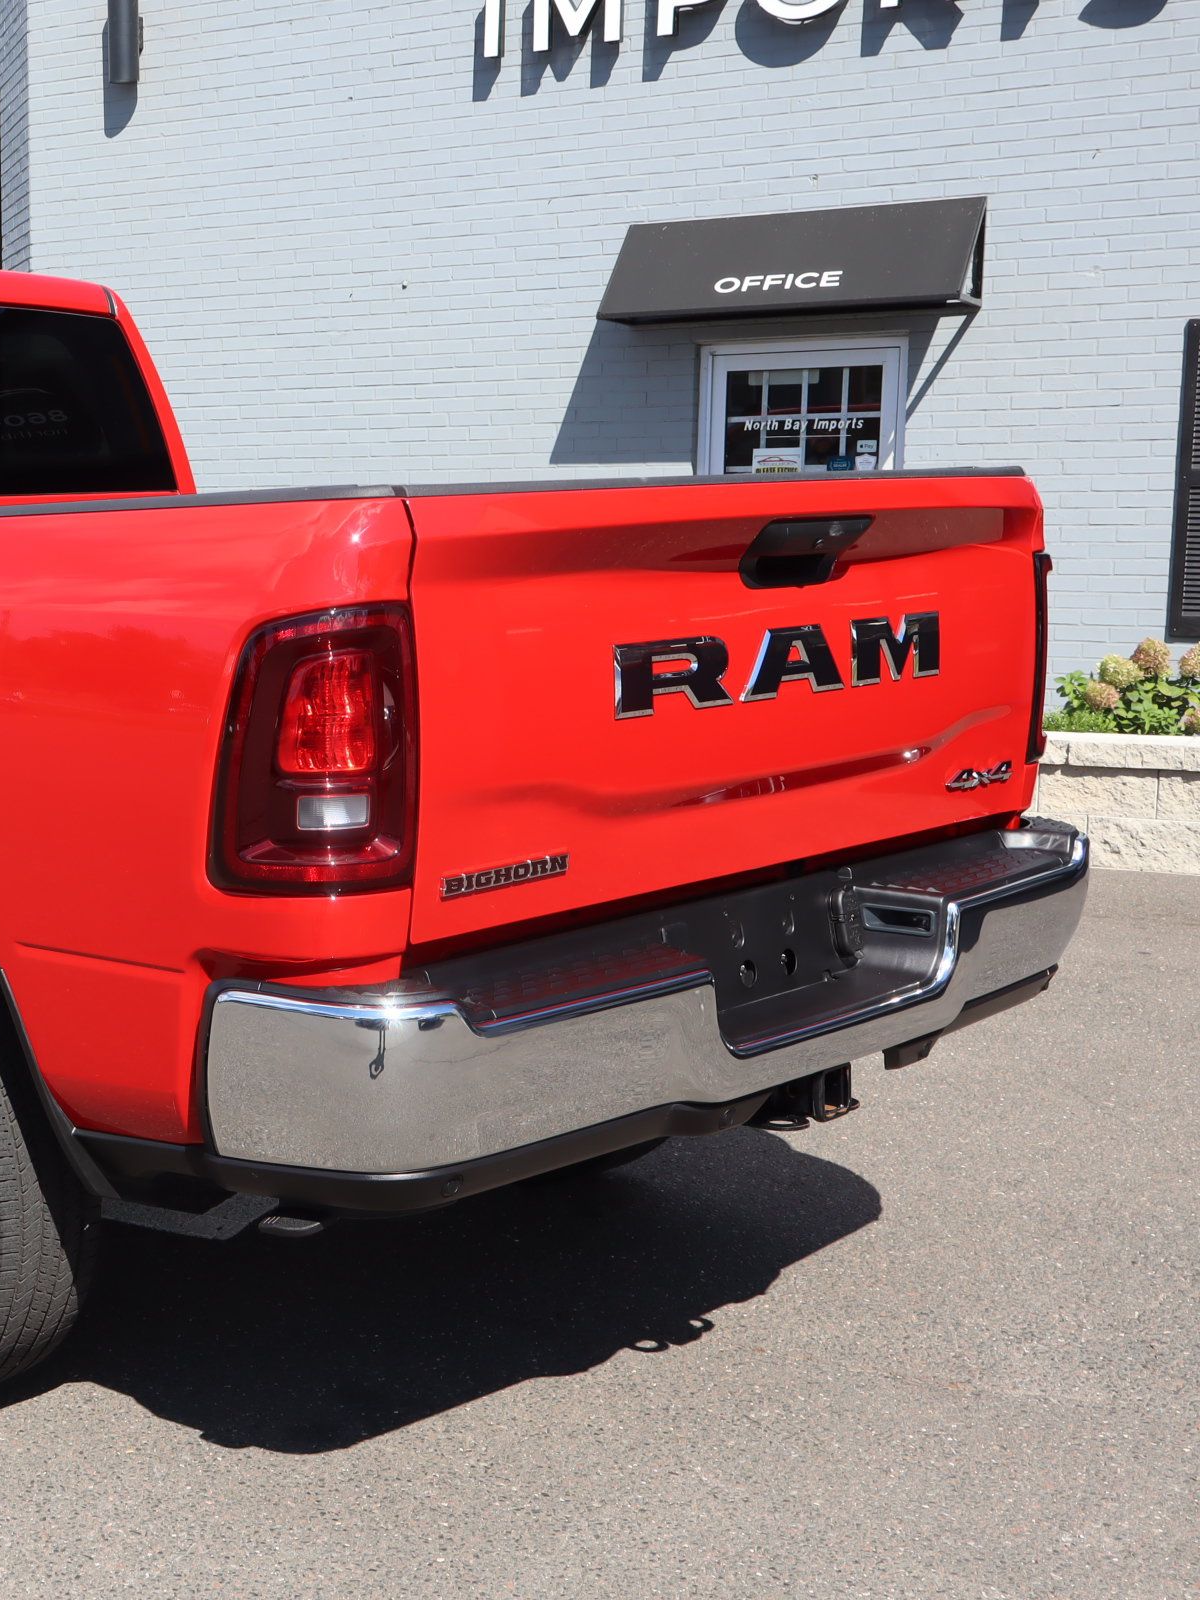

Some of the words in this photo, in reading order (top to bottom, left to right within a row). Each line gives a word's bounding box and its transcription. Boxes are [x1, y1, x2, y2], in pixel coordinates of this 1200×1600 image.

[713, 270, 844, 294] OFFICE
[743, 418, 779, 431] North
[783, 418, 808, 433] Bay
[812, 417, 864, 432] Imports
[613, 610, 940, 720] RAM
[440, 853, 570, 897] BIGHORN
